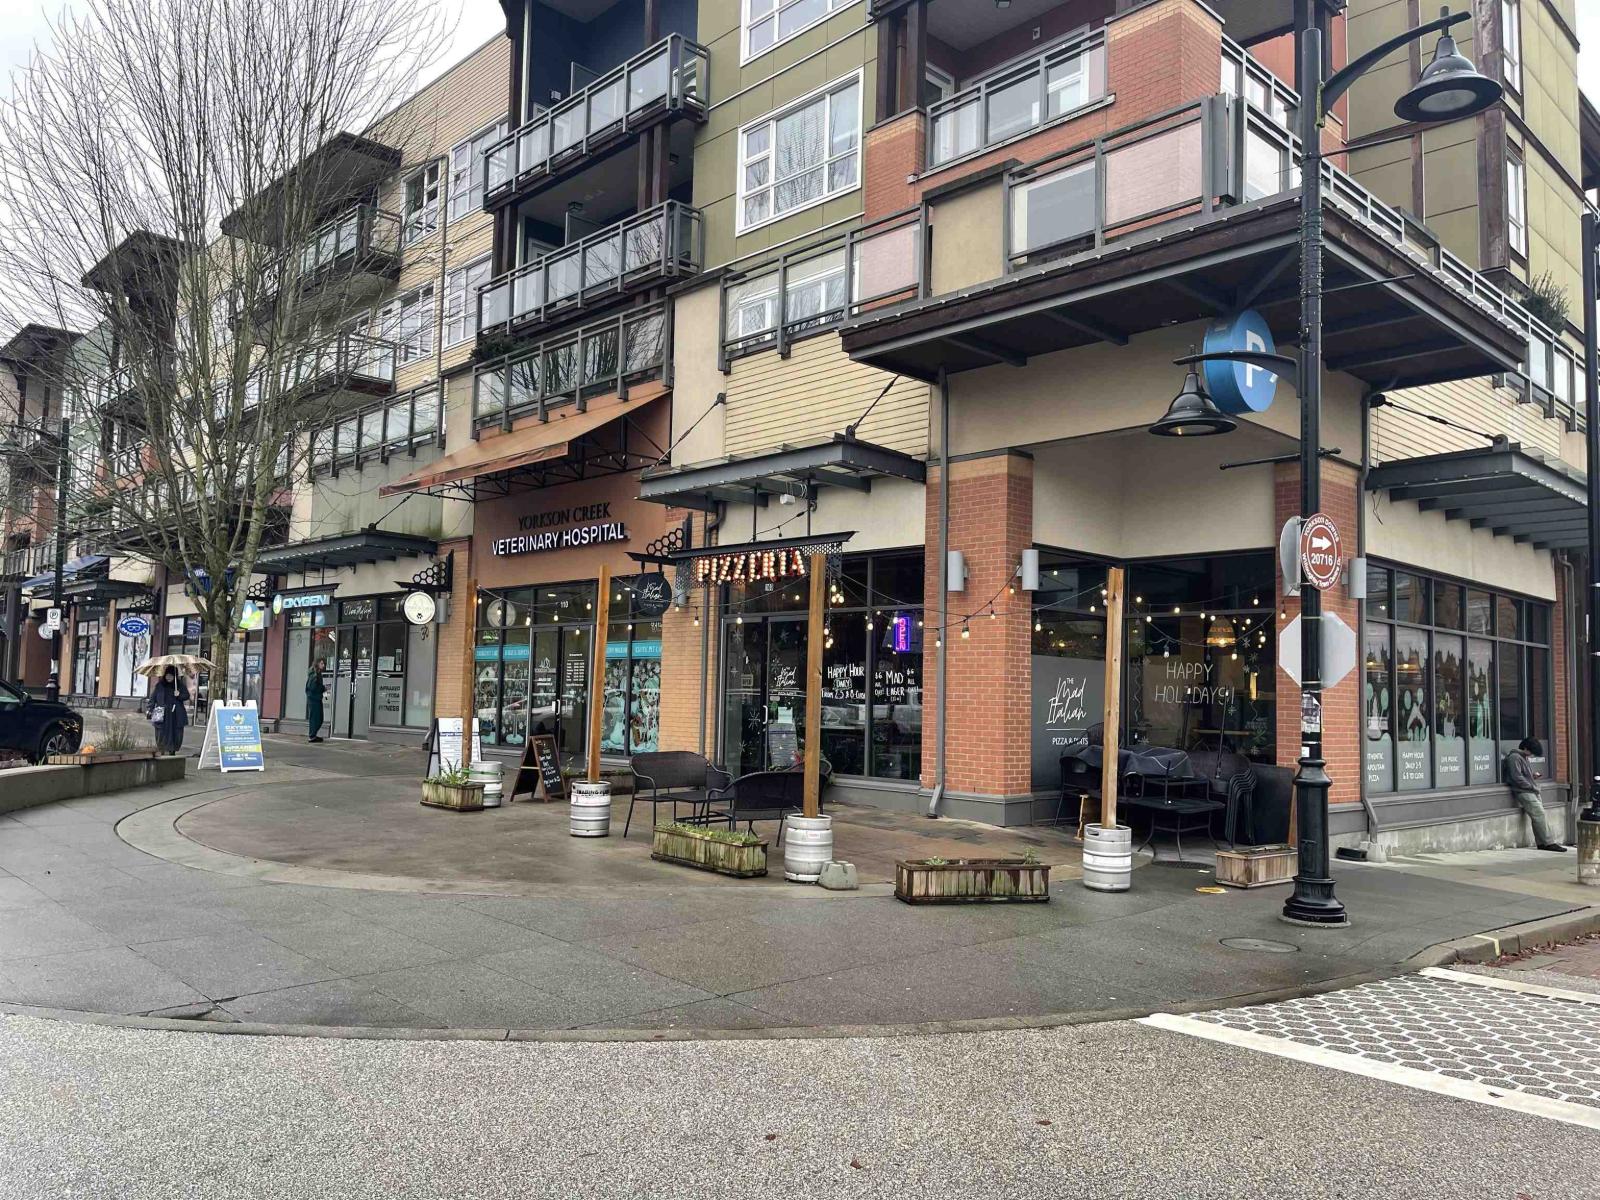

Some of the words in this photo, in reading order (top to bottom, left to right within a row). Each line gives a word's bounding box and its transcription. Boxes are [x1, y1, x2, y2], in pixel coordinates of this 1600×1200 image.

[518, 508, 571, 531] YORKSON
[573, 502, 611, 521] CREEK
[492, 532, 560, 555] VETERINARY
[562, 522, 625, 546] HOSPITAL
[695, 549, 806, 582] PIZZERIA
[1311, 553, 1334, 566] 20716
[283, 594, 330, 609] OXYGEN
[827, 664, 848, 679] HAPPY
[849, 663, 865, 677] HOUR
[885, 670, 904, 685] MAD
[1166, 661, 1214, 682] HAPPY
[1066, 677, 1074, 685] THE
[886, 687, 905, 697] LAGER
[1056, 677, 1087, 707] Mad
[1052, 737, 1068, 746] PIZZA
